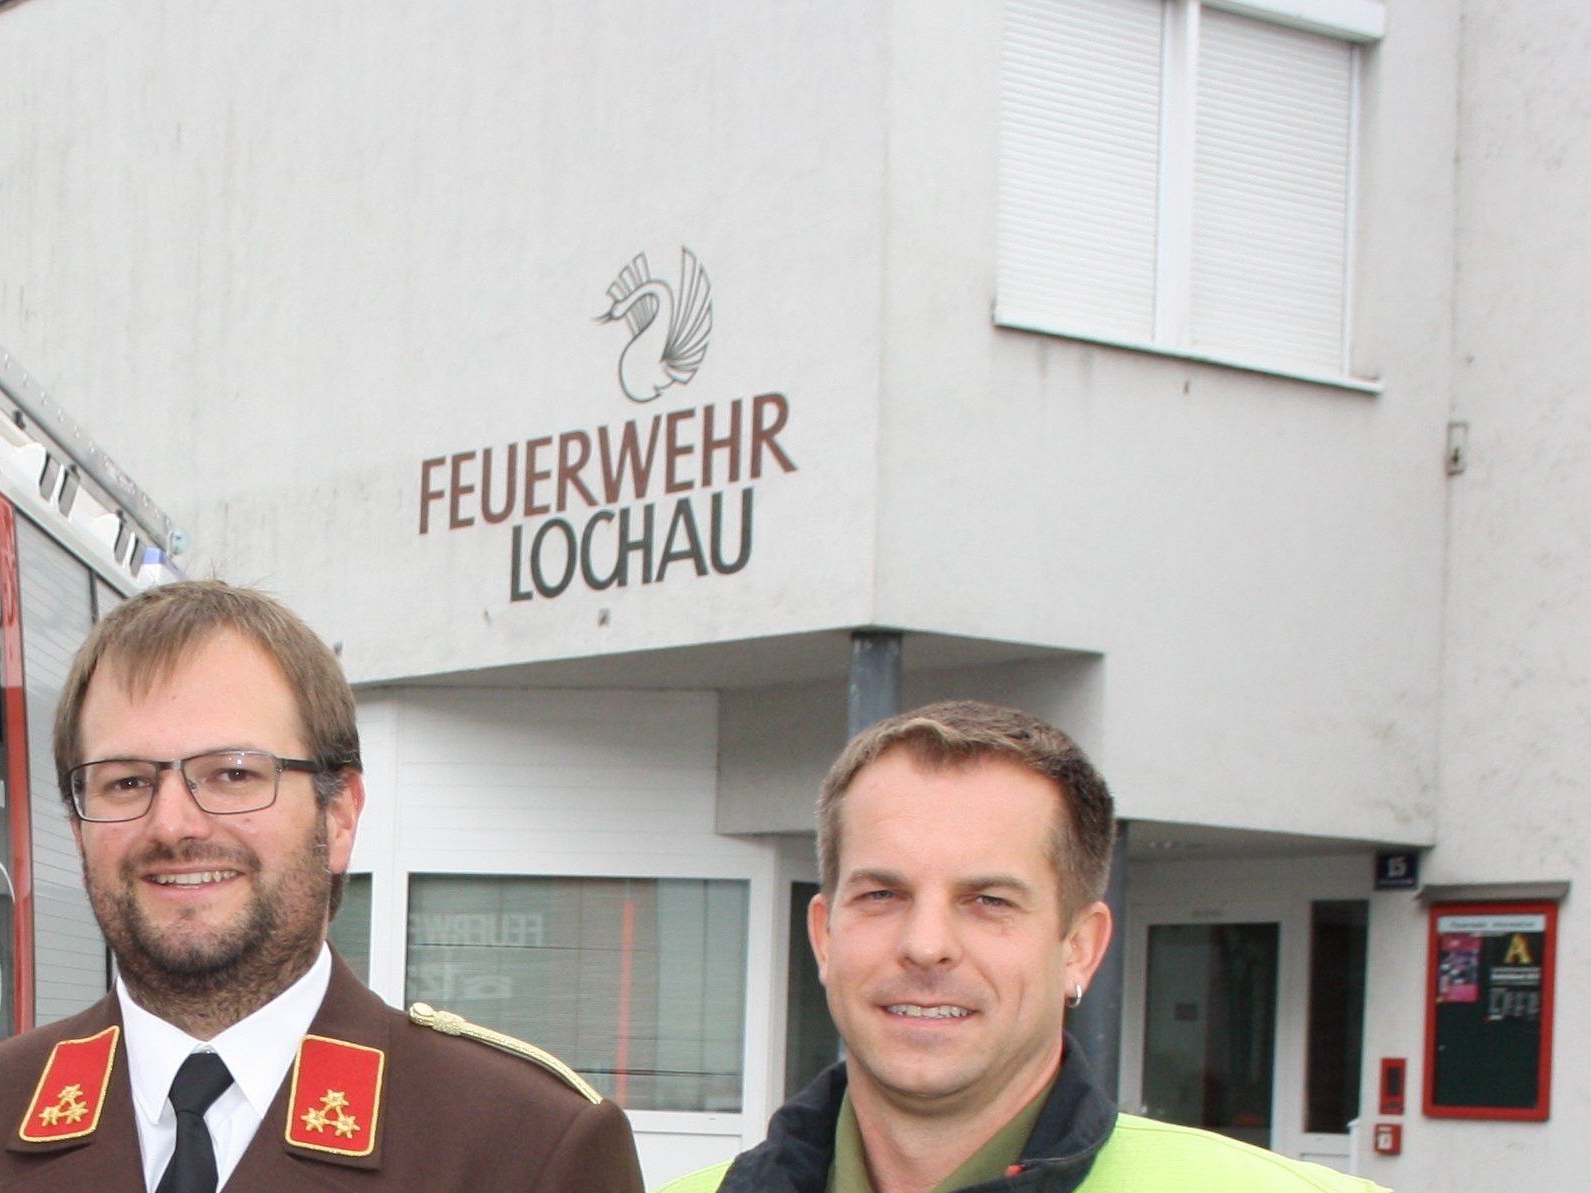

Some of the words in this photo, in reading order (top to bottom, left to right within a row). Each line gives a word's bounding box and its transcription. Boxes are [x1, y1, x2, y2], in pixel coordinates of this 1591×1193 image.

[419, 392, 798, 535] FEUERWEHR
[510, 486, 754, 602] LOCHAU
[1503, 933, 1533, 964] A
